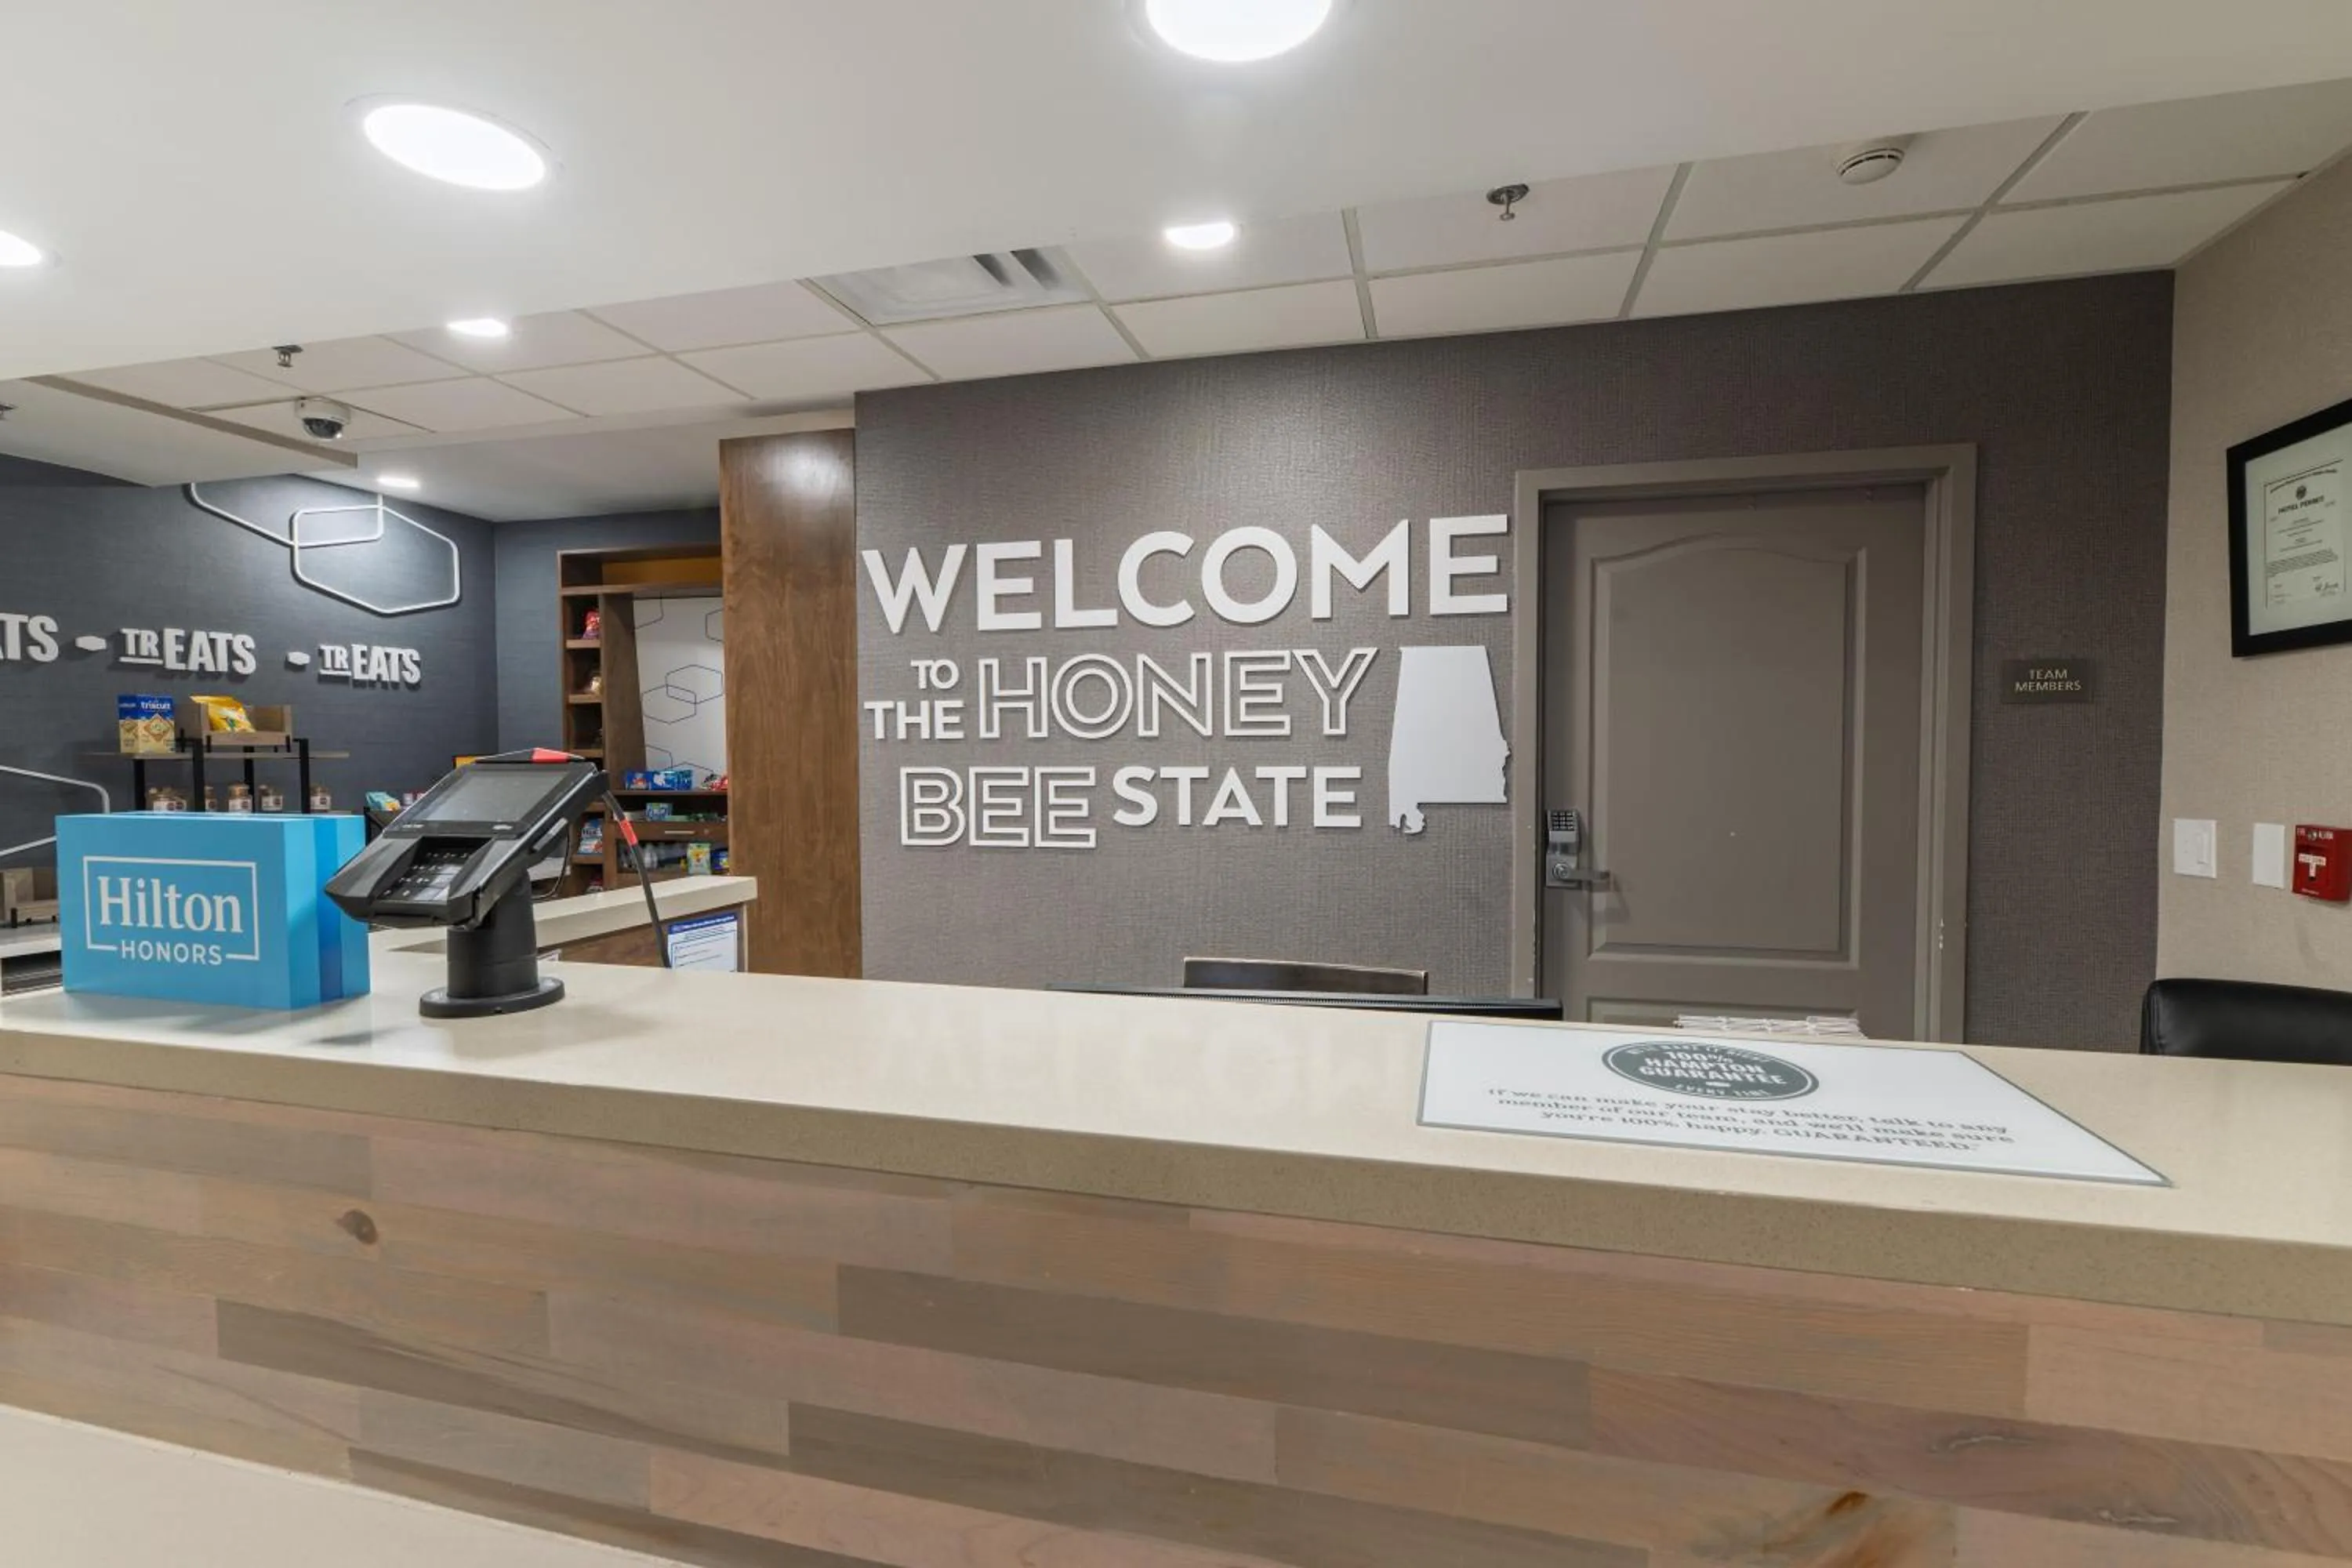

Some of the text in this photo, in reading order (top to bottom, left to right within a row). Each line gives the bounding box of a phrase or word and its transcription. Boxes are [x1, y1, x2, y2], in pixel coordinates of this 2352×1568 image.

[862, 514, 1508, 633] WELCOME
[0, 613, 59, 662] TS
[119, 628, 256, 674] TREATS
[319, 643, 421, 684] TREATS
[910, 659, 959, 689] TO
[2029, 669, 2068, 680] TEAM
[978, 647, 1377, 739] HONEY
[2015, 680, 2082, 691] MEMBERS
[863, 699, 964, 739] THE
[900, 766, 1361, 848] BEE STATE
[97, 876, 243, 933] Hilton
[122, 940, 222, 965] HONORS
[1637, 1065, 1788, 1085] GUARANTEE
[1643, 1057, 1766, 1074] HAMPTON
[1665, 1051, 1735, 1064] 100%
[1498, 1098, 1589, 1110] member
[1627, 1108, 1669, 1116] our
[1750, 1116, 1799, 1127] and
[1871, 1126, 1947, 1137] make
[1949, 1132, 2016, 1143] sure
[1595, 1097, 1657, 1107] make
[1664, 1102, 1720, 1112] your
[1726, 1105, 1777, 1116] stay
[1867, 1116, 1922, 1127] talk
[1926, 1120, 1956, 1128] to
[1958, 1124, 2009, 1134] any
